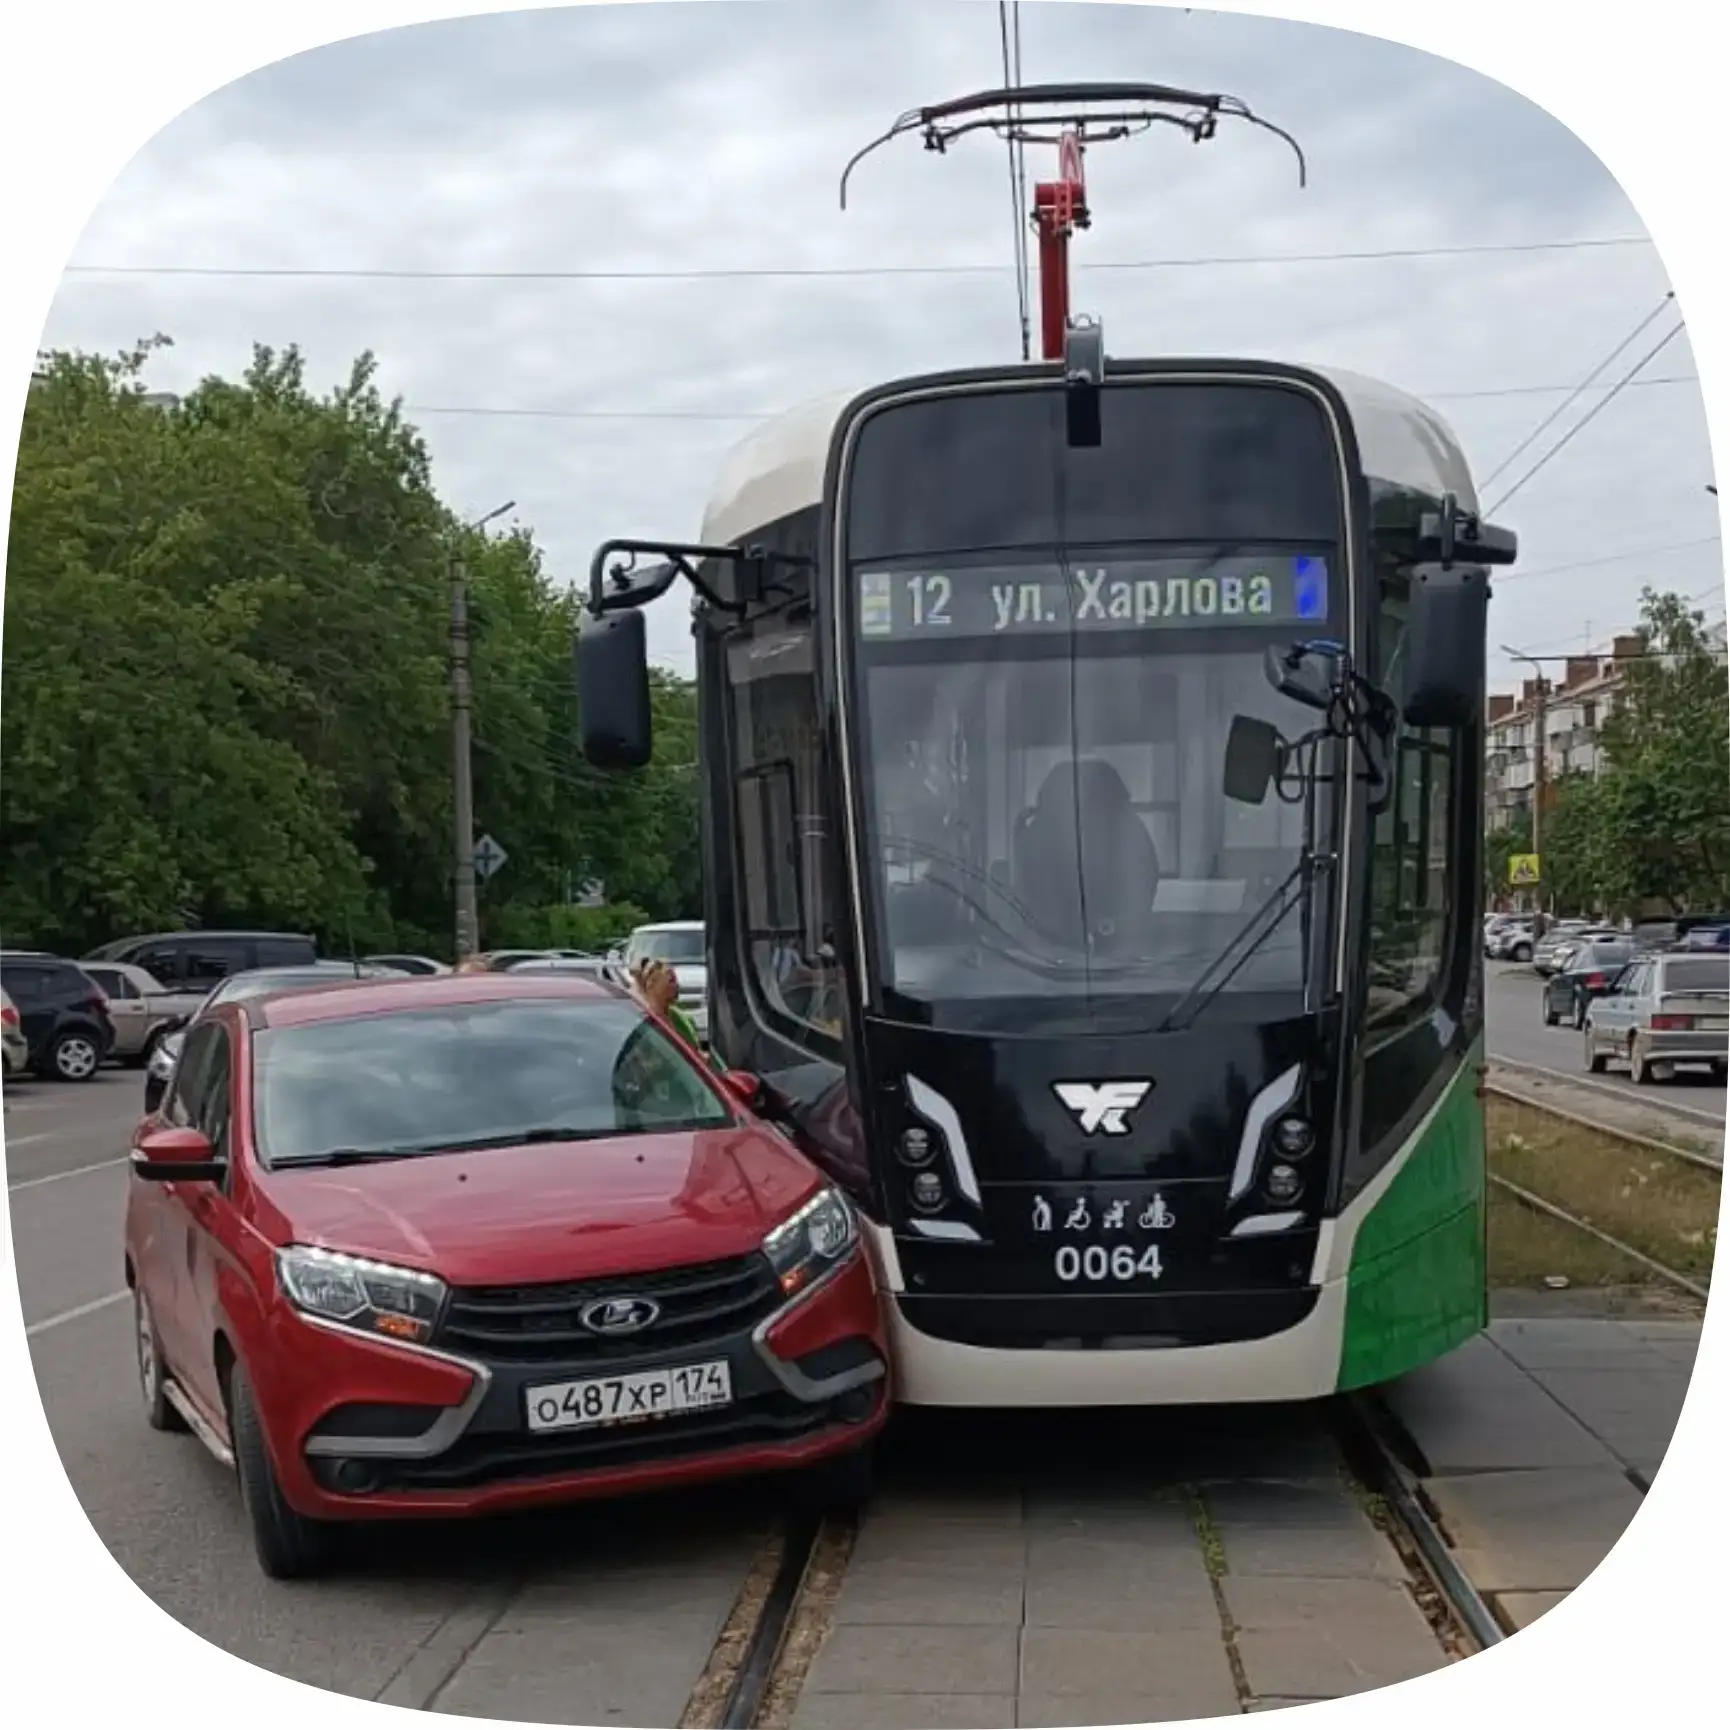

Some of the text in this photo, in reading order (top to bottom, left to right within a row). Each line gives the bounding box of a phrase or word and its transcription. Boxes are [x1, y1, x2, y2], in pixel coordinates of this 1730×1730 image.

[906, 568, 1272, 630] 12 ул. Харлова
[1055, 1245, 1163, 1280] 0064
